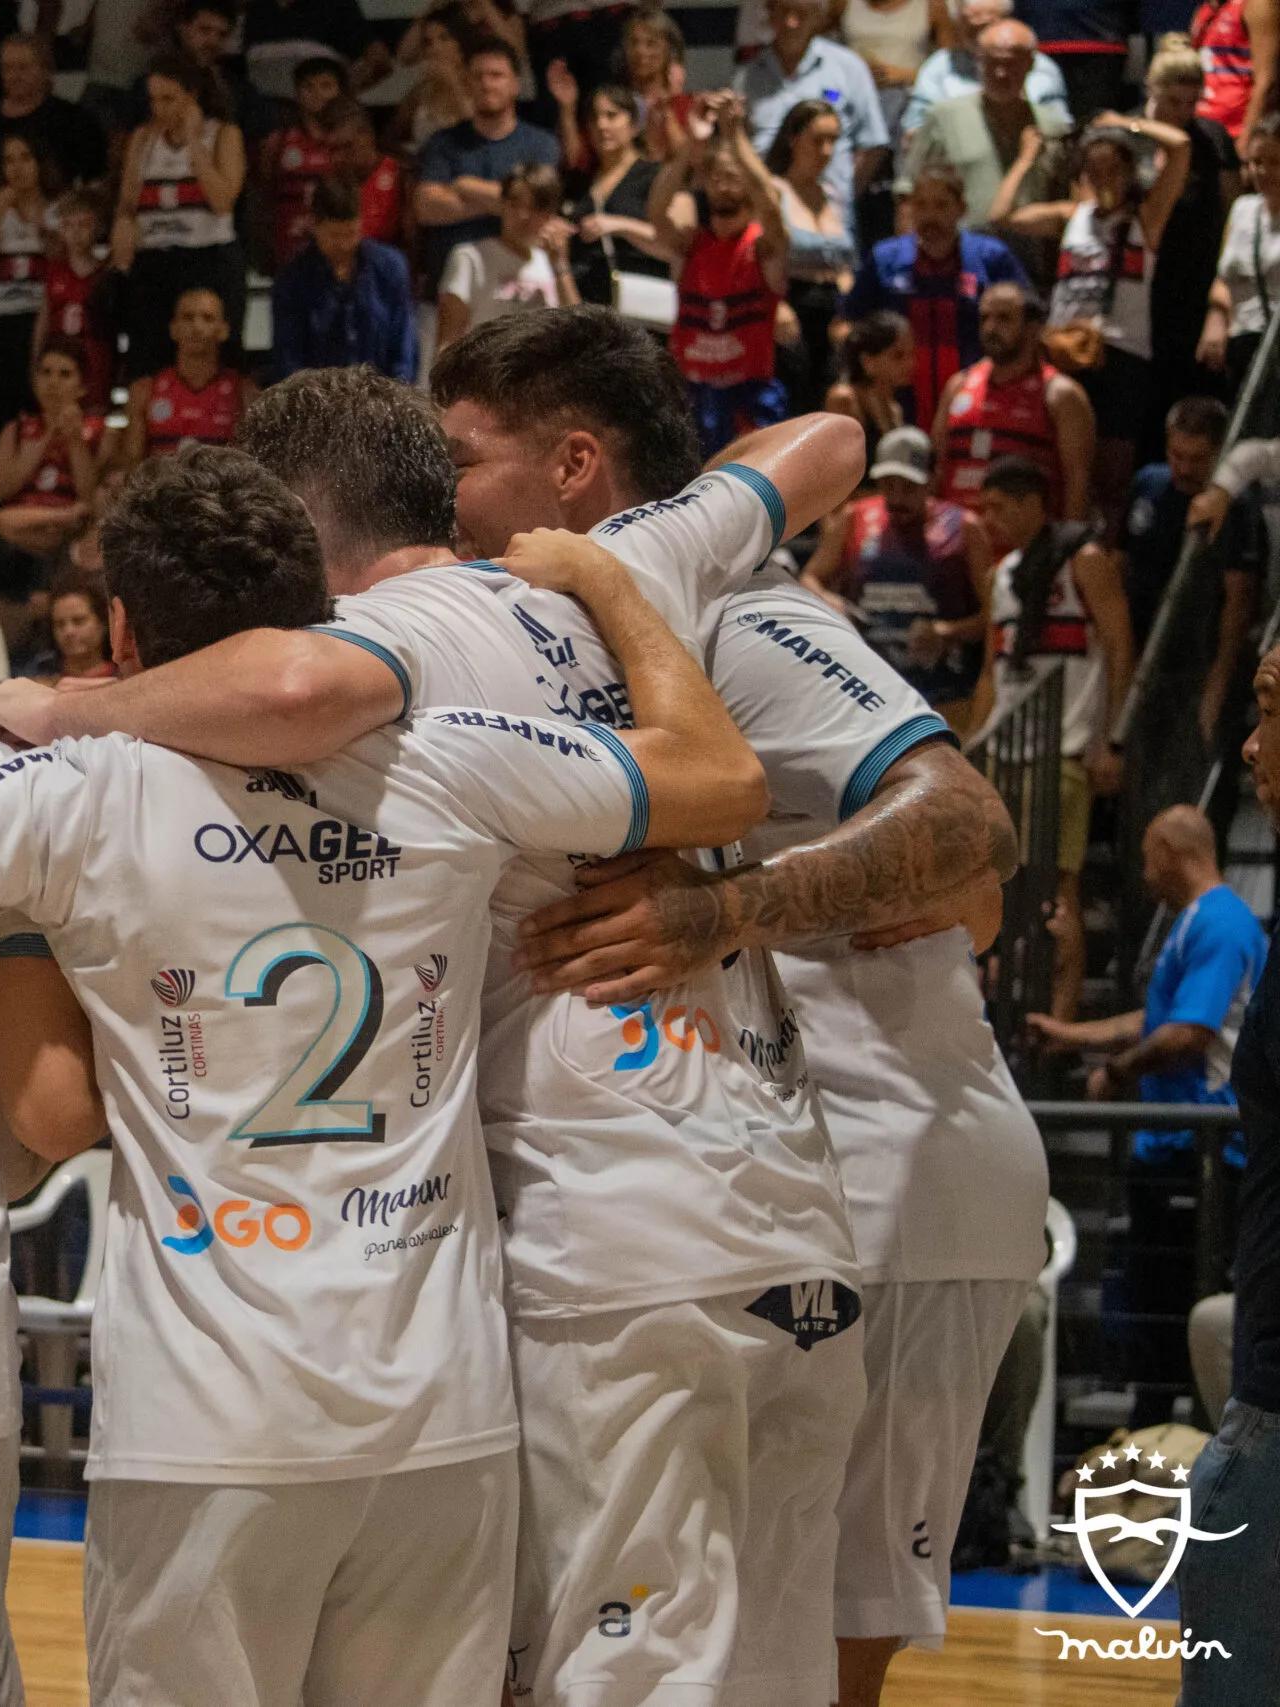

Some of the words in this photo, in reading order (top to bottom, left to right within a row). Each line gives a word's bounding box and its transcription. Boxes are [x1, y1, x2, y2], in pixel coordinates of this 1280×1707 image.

[755, 619, 886, 713] MAPFRE
[433, 711, 586, 760] MAPFRE
[318, 856, 401, 885] SPORT
[158, 1015, 190, 1119] Cortiluz
[187, 1012, 207, 1078] CORTINAS
[224, 922, 386, 1149] 2
[410, 1000, 437, 1108] Cortiluz
